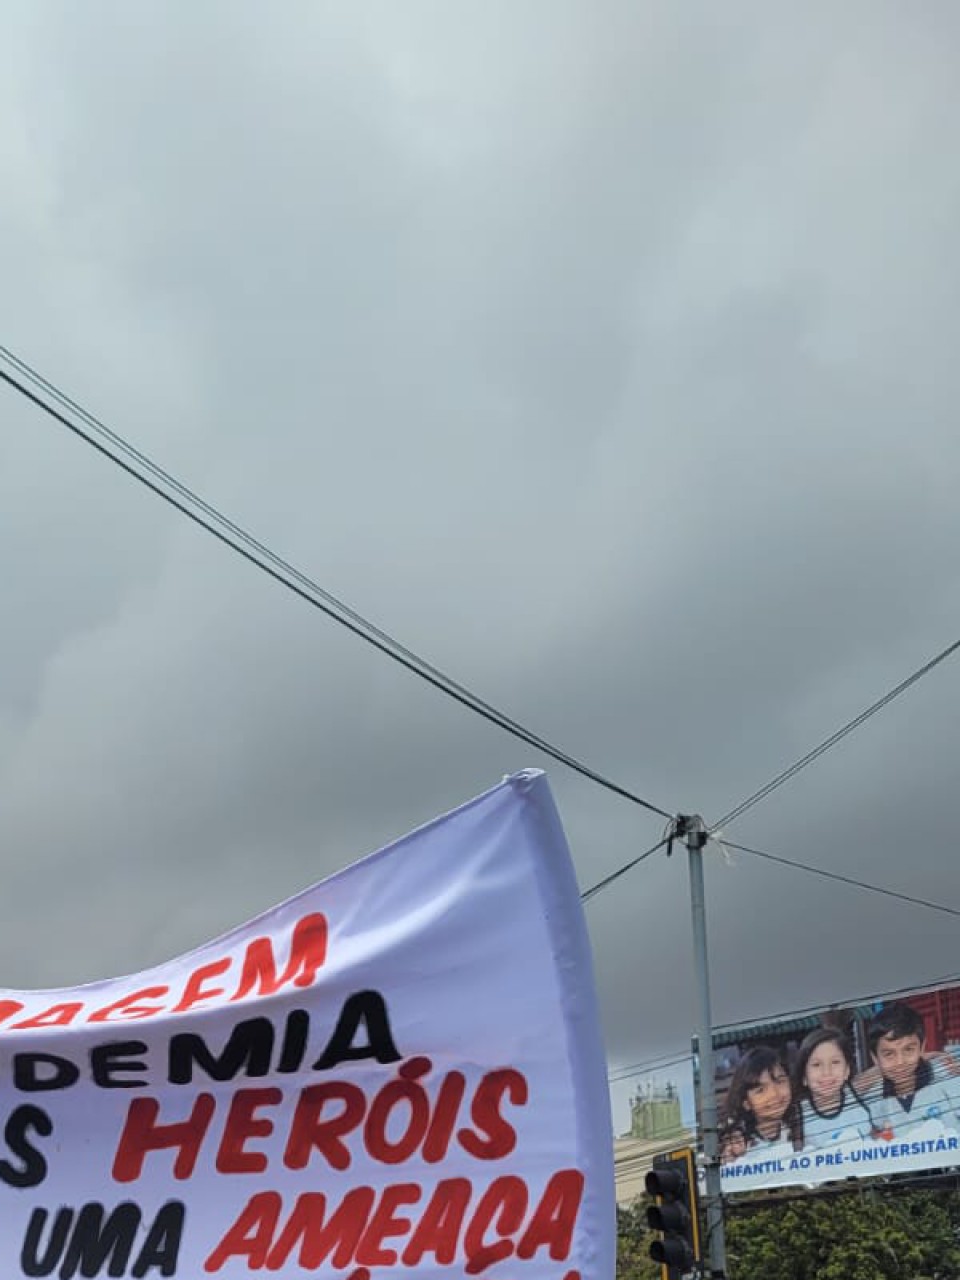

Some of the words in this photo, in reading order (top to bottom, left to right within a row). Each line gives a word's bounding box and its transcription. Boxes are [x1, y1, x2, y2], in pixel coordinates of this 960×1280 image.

[112, 1056, 528, 1183] HERÓIS
[790, 1156, 811, 1170] AO
[20, 1201, 186, 1280] UMA
[204, 1169, 585, 1275] AMEAÇA
